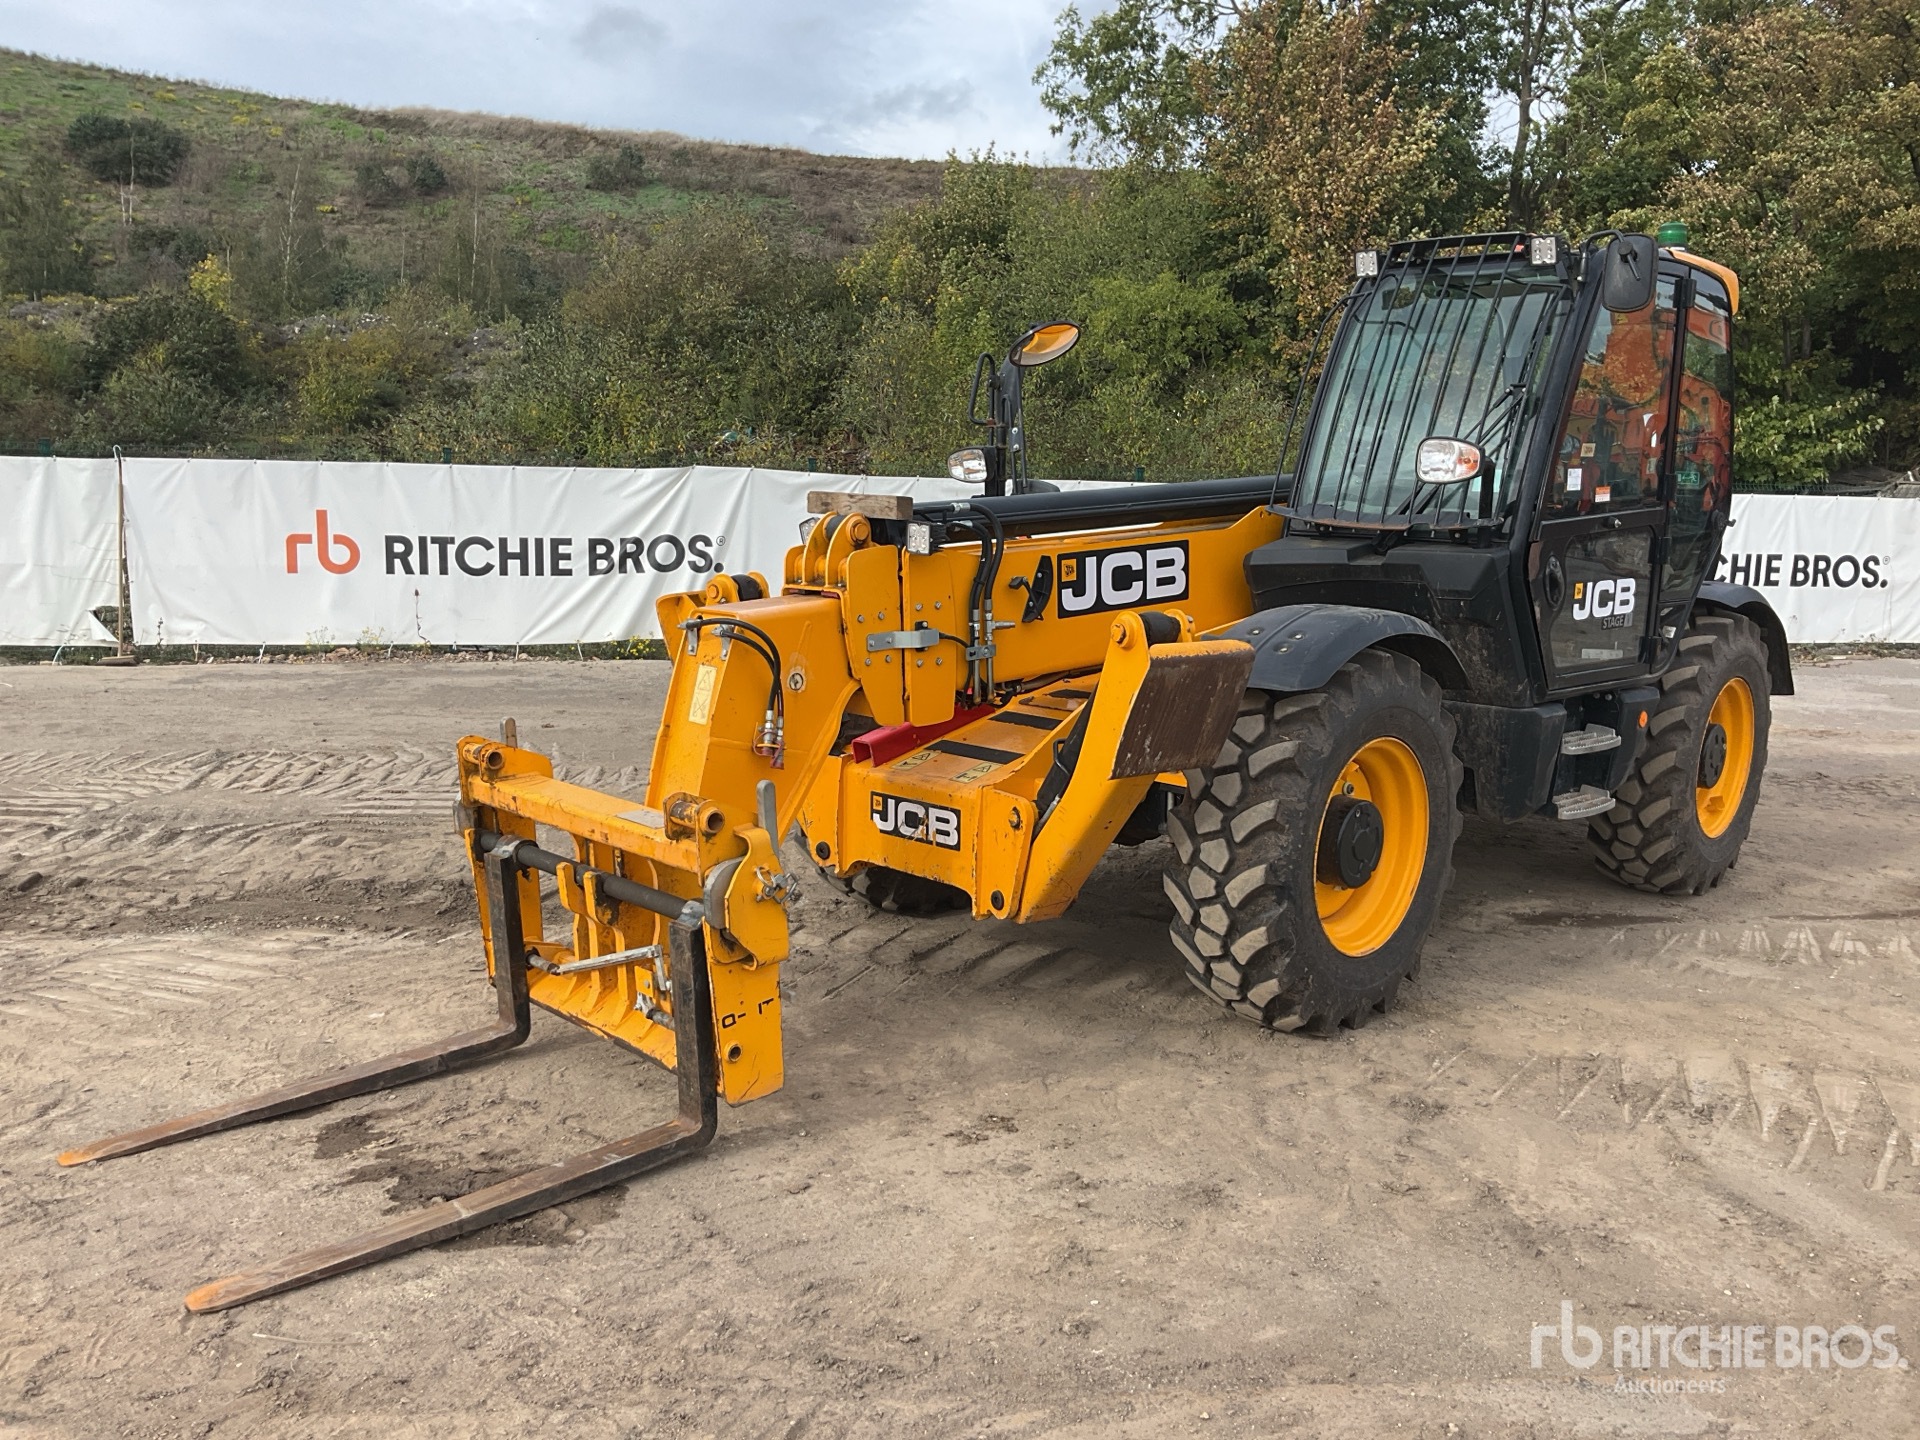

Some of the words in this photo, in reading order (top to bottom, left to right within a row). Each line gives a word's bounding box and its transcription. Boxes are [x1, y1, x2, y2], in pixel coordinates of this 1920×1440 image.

[286, 509, 361, 575] rb
[385, 534, 573, 577] RITCHIE
[1061, 546, 1187, 612] JCB
[1572, 577, 1636, 621] JCB
[1602, 614, 1624, 629] STAGE
[872, 798, 959, 846] JCB
